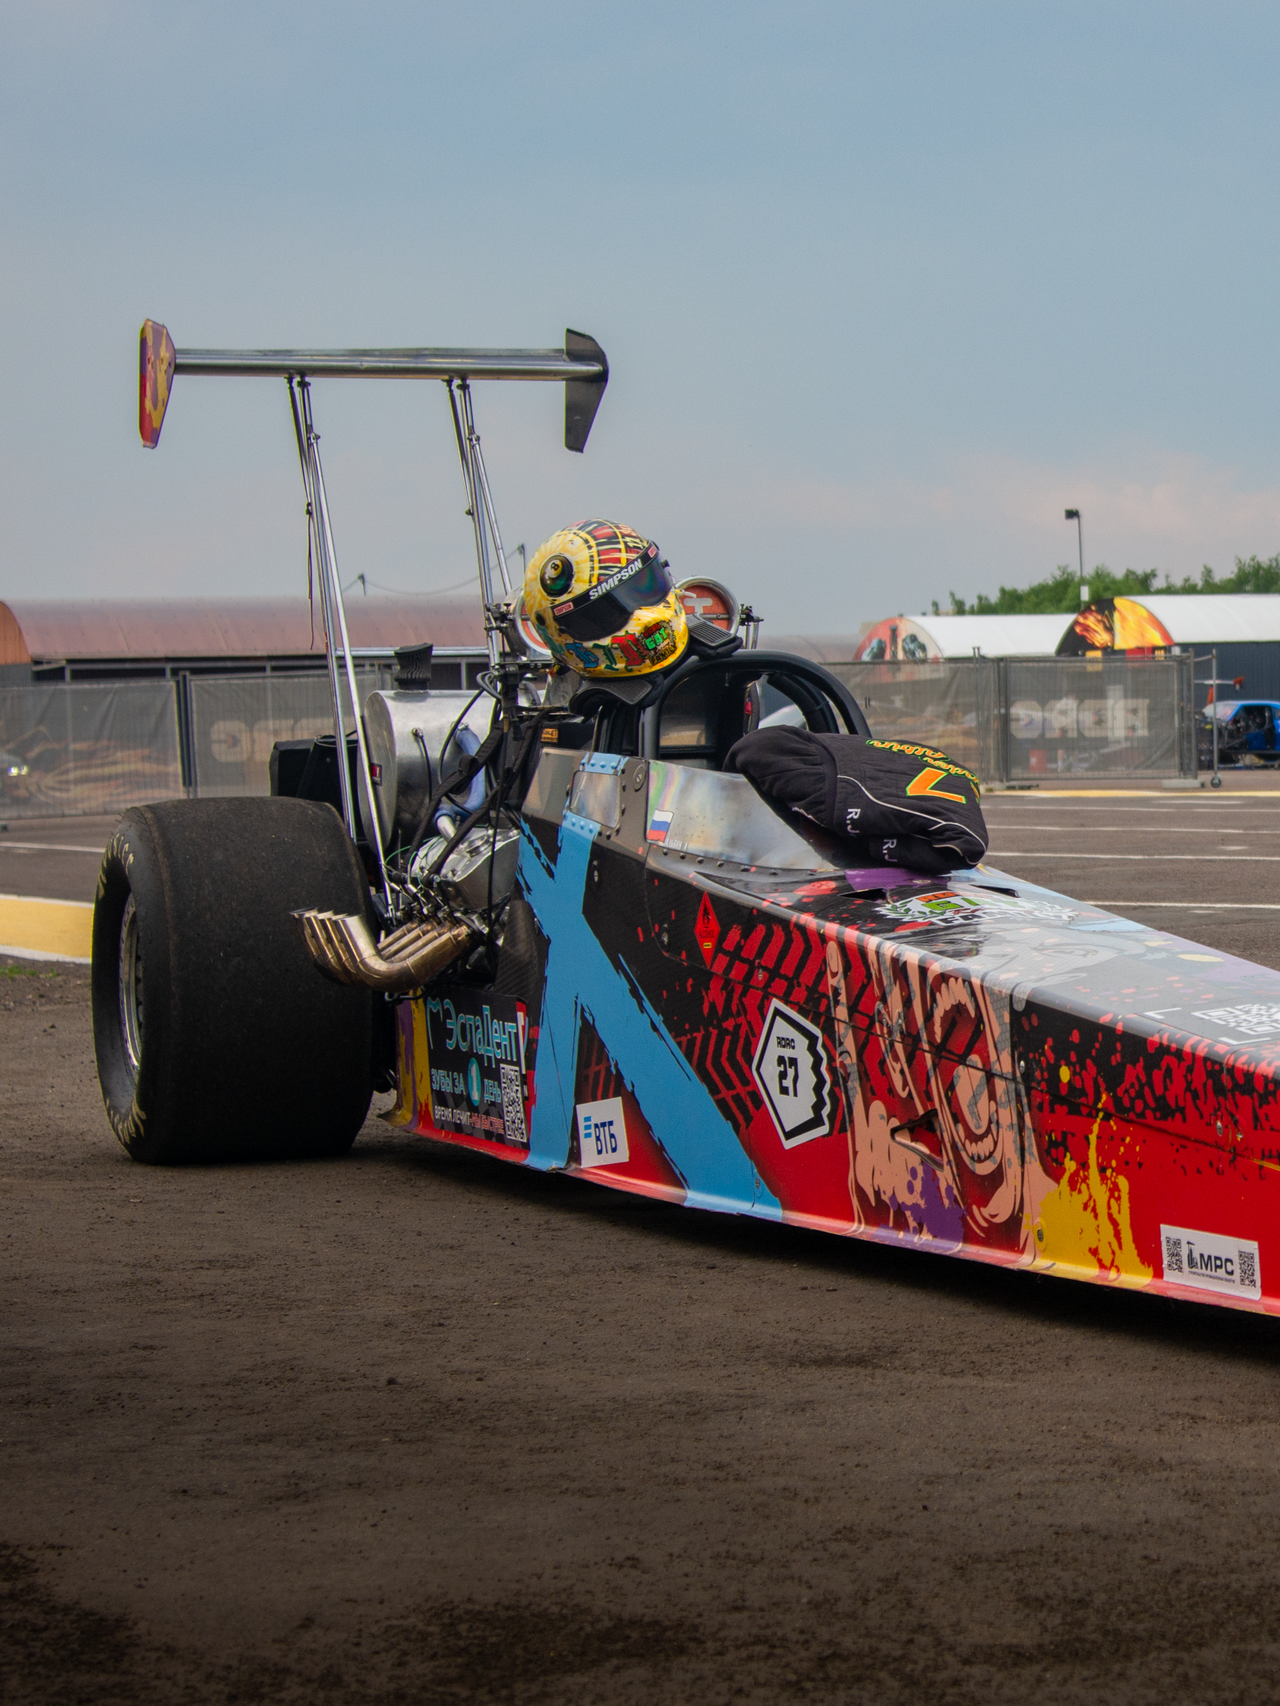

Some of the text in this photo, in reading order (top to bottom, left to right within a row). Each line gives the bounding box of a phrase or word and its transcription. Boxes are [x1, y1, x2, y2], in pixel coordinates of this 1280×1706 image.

[589, 558, 643, 600] SIMPSON
[776, 1036, 796, 1050] RDRC
[431, 1068, 453, 1093] ЗУБЫ
[453, 1072, 466, 1096] ЗА
[484, 1078, 501, 1104] ДЕНЬ
[776, 1054, 800, 1098] 27
[434, 1105, 452, 1121] ВРЕМЯ
[481, 1115, 505, 1135] БЫСТРЕЕ
[593, 1120, 618, 1156] ВТБ
